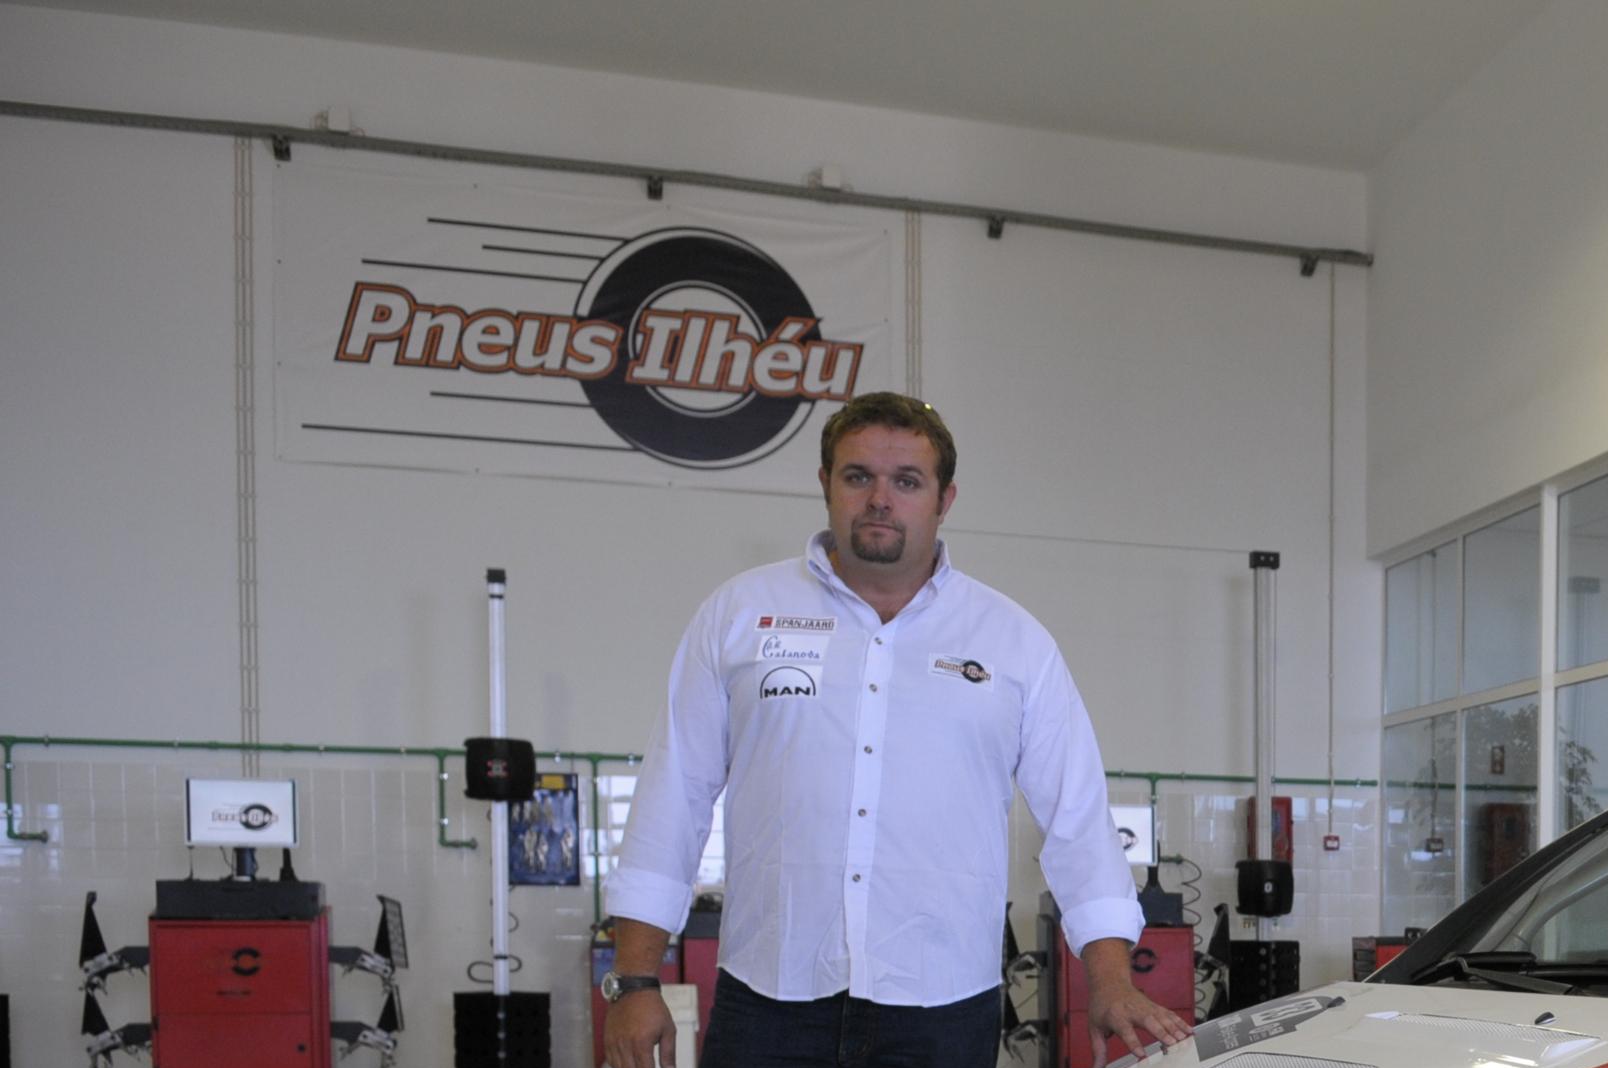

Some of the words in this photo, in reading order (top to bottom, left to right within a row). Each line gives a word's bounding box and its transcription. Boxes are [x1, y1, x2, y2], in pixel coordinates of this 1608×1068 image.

[337, 283, 622, 378] Pneus
[627, 311, 862, 399] Ilhéu
[764, 686, 811, 697] MAN
